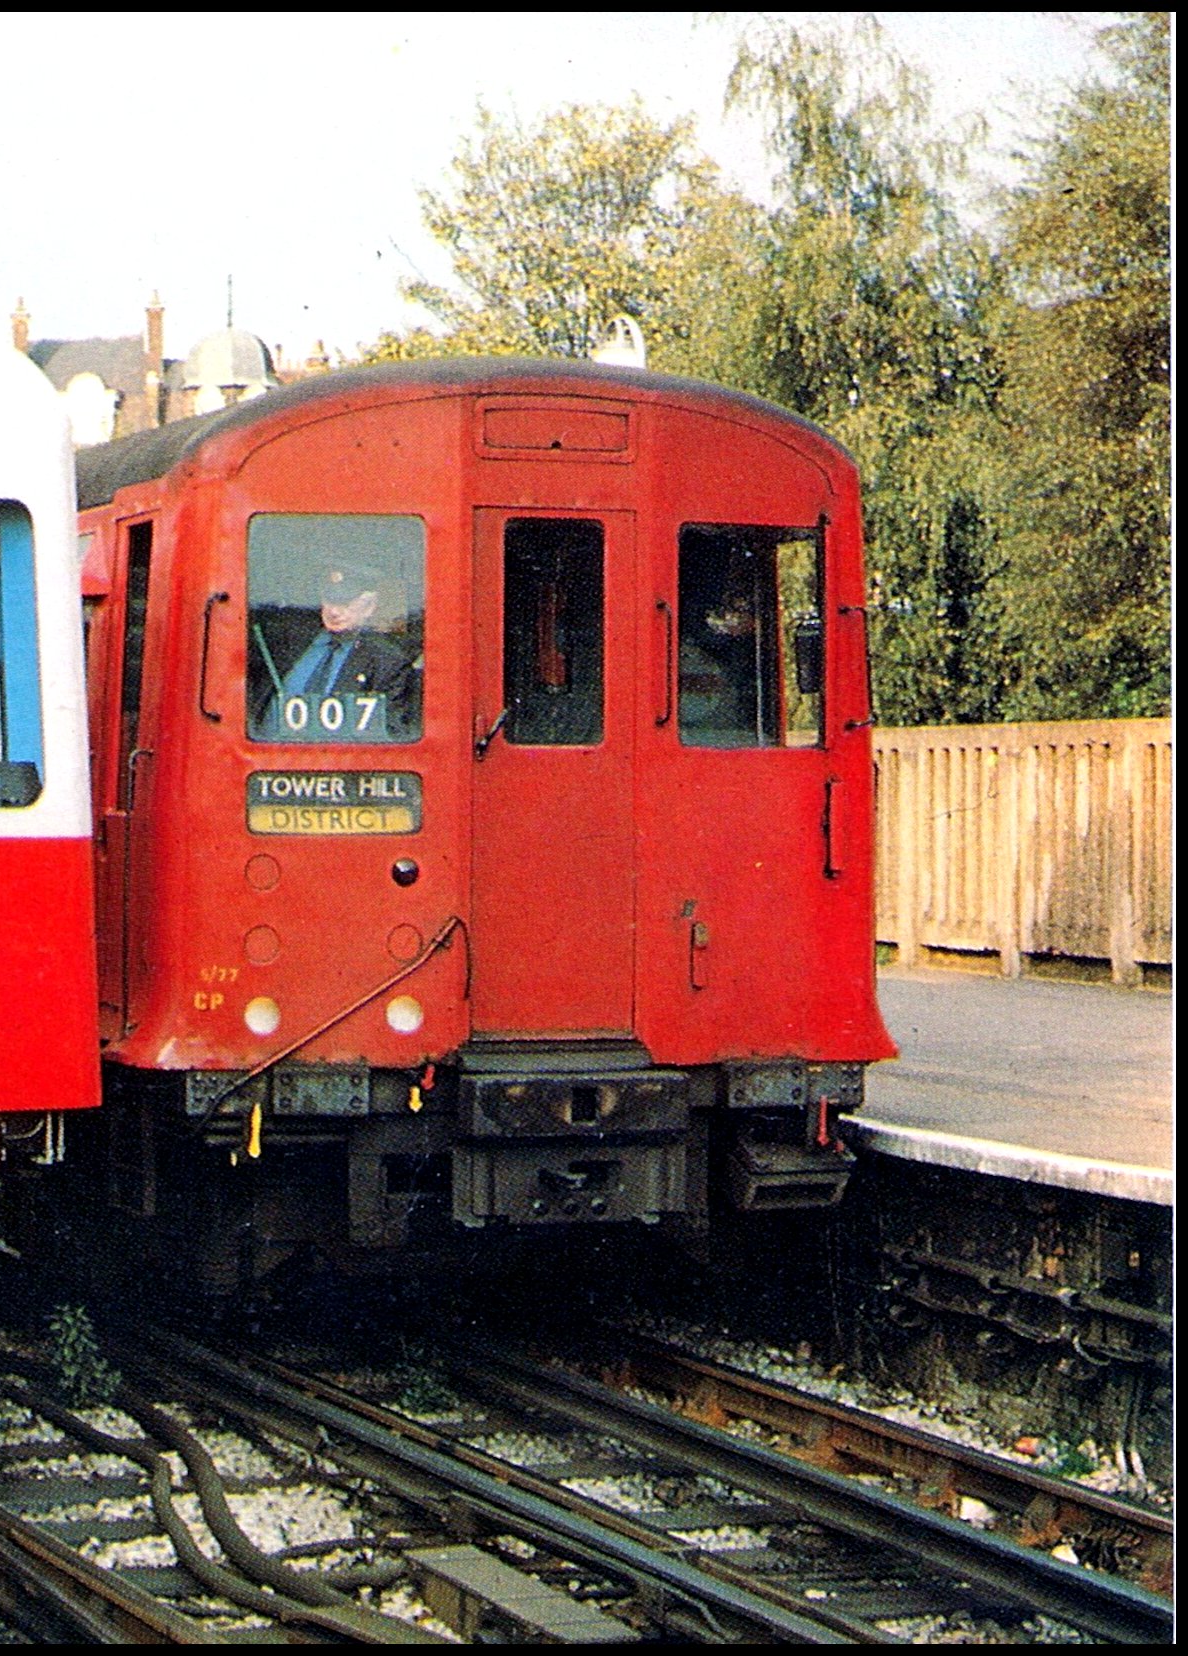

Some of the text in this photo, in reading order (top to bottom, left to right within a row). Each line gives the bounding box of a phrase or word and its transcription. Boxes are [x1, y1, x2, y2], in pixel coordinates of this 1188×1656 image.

[285, 697, 377, 731] 007
[258, 777, 406, 798] TOWER HILL
[272, 809, 389, 829] DISTRICT
[193, 992, 224, 1010] CP
